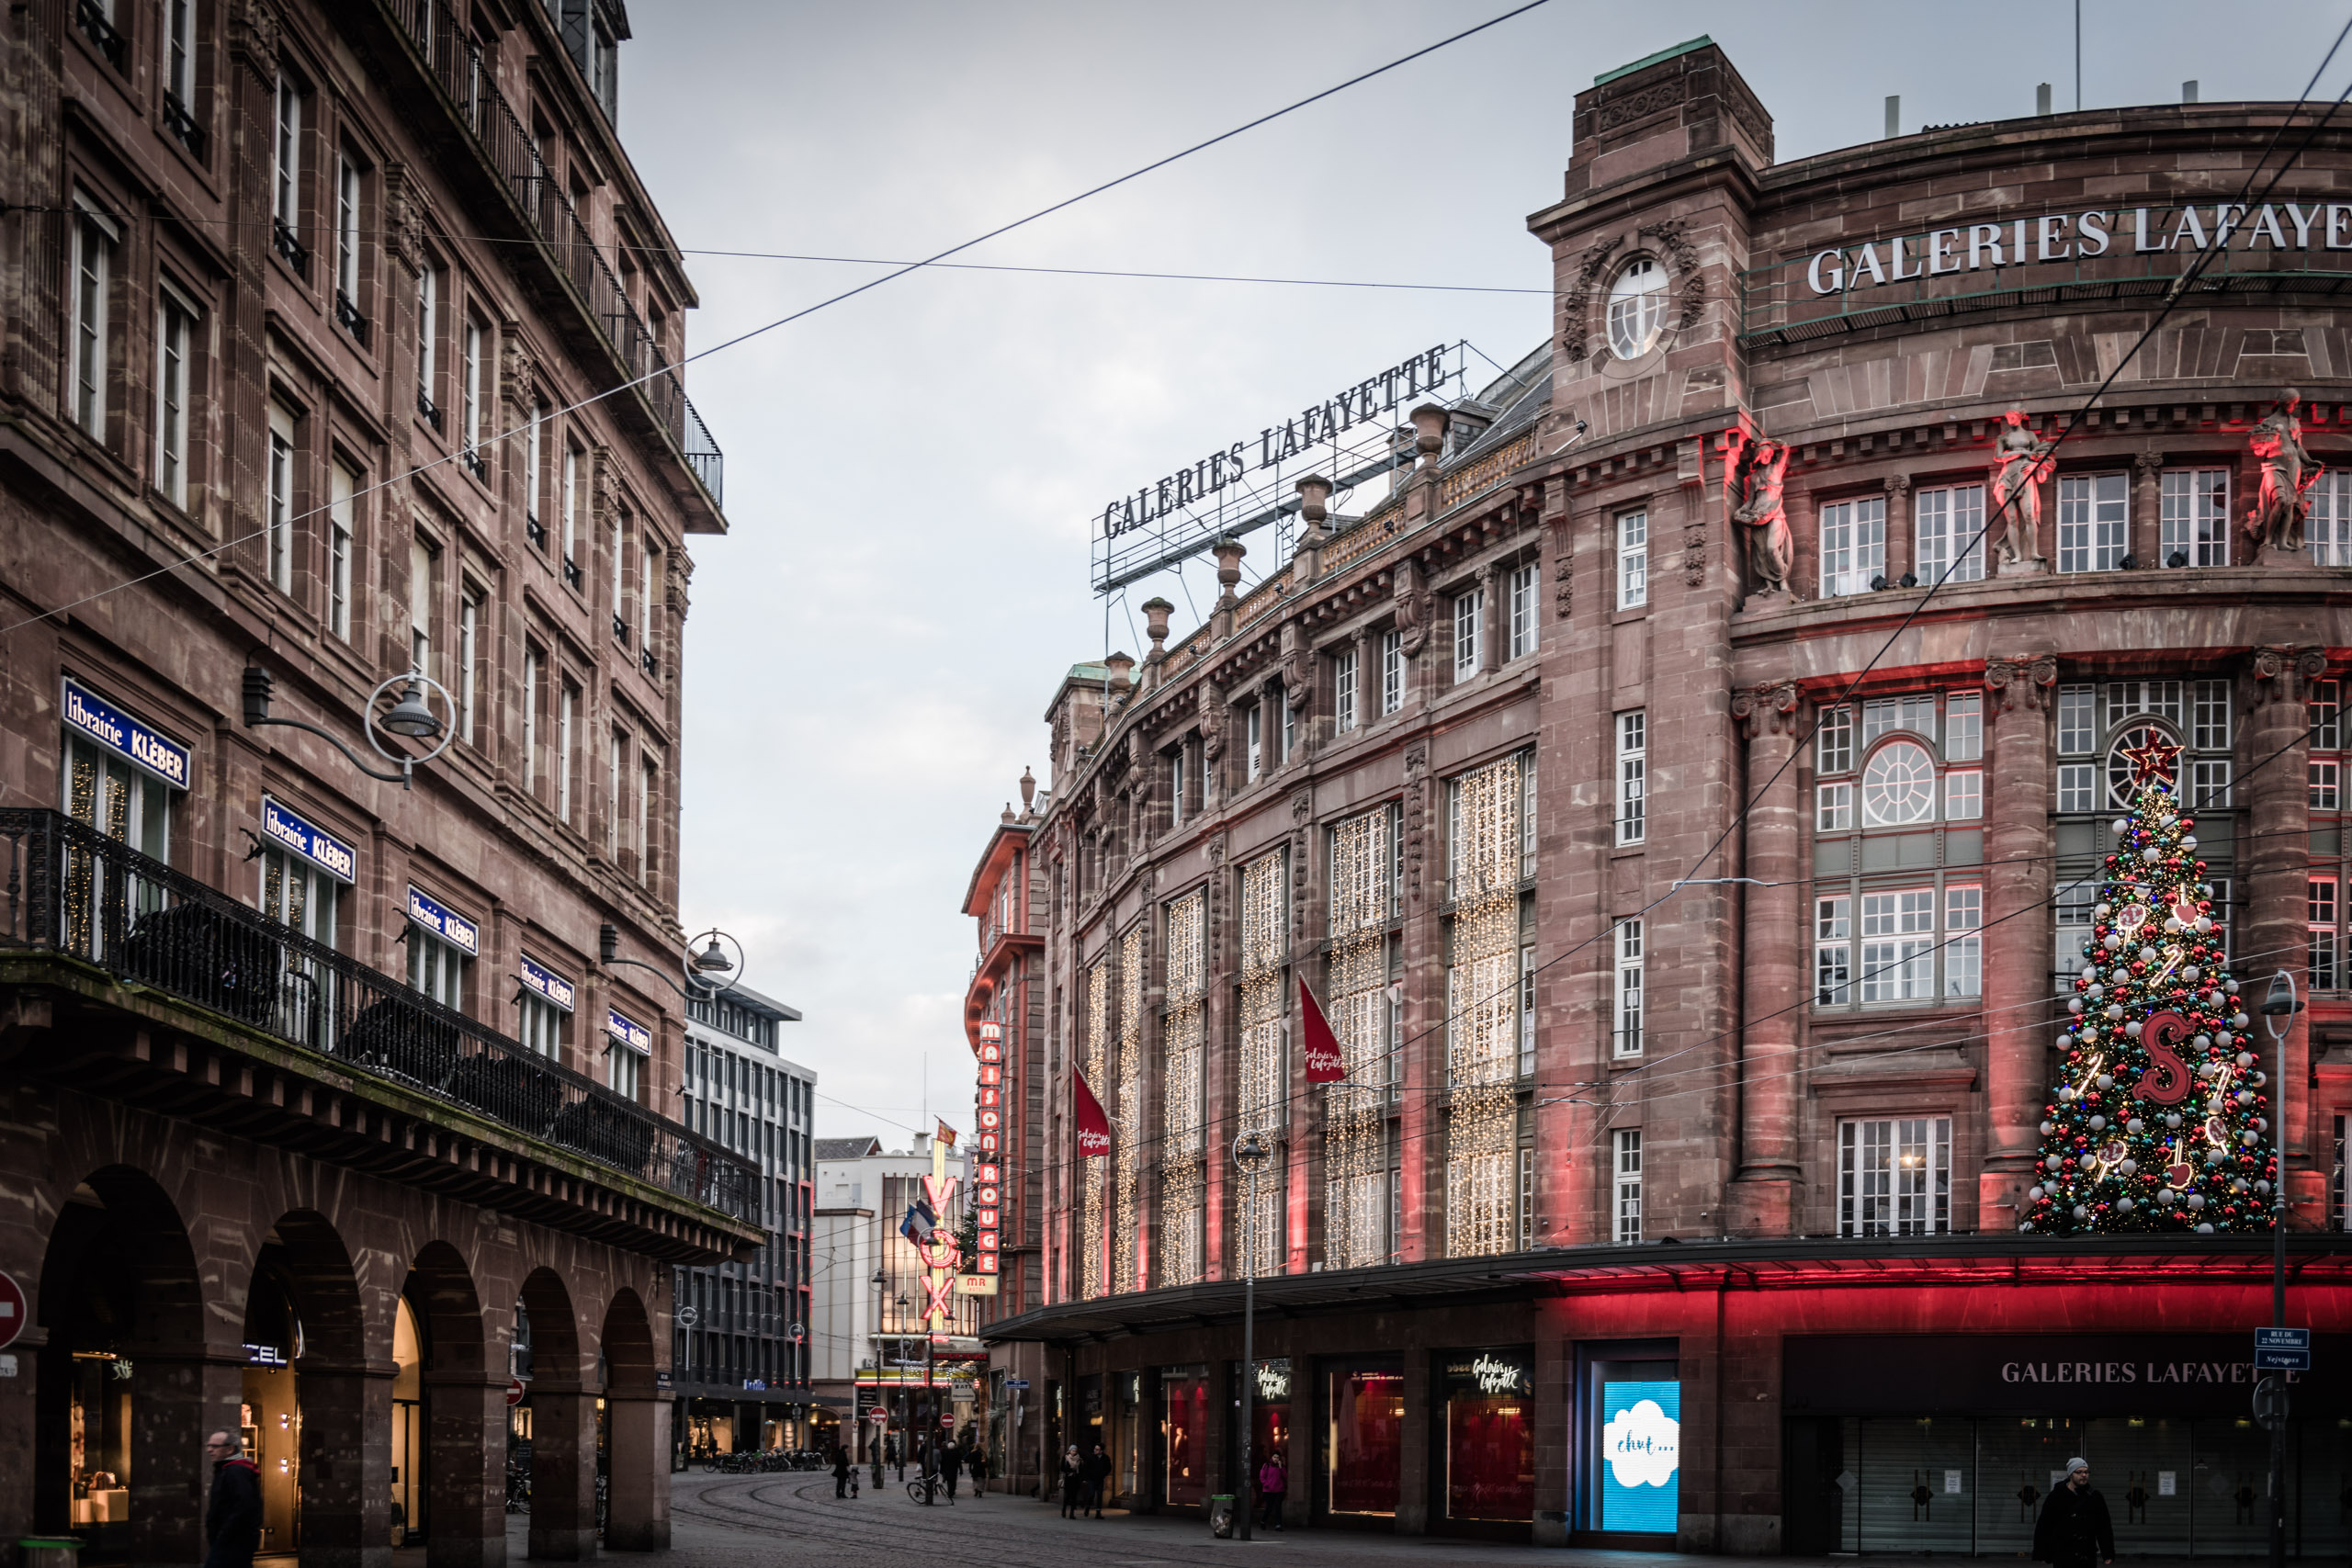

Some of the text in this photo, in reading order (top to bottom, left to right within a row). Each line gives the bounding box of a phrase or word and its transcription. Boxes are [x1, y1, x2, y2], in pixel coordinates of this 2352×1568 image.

[1807, 210, 2109, 296] GALERIES
[1104, 344, 1446, 538] GALERIES LAFAYETTE
[68, 691, 123, 747] librairie
[266, 807, 308, 852] librairie
[410, 894, 442, 931] librairie
[521, 962, 546, 992] librairie
[981, 1022, 1001, 1270] MAISON ROUGE
[967, 1277, 986, 1286] MR
[1472, 1353, 1504, 1379] Galeries
[1480, 1365, 1521, 1393] Lafayette
[2001, 1362, 2301, 1384] GALERIES LAFAYETE
[1617, 1429, 1674, 1455] chut...
